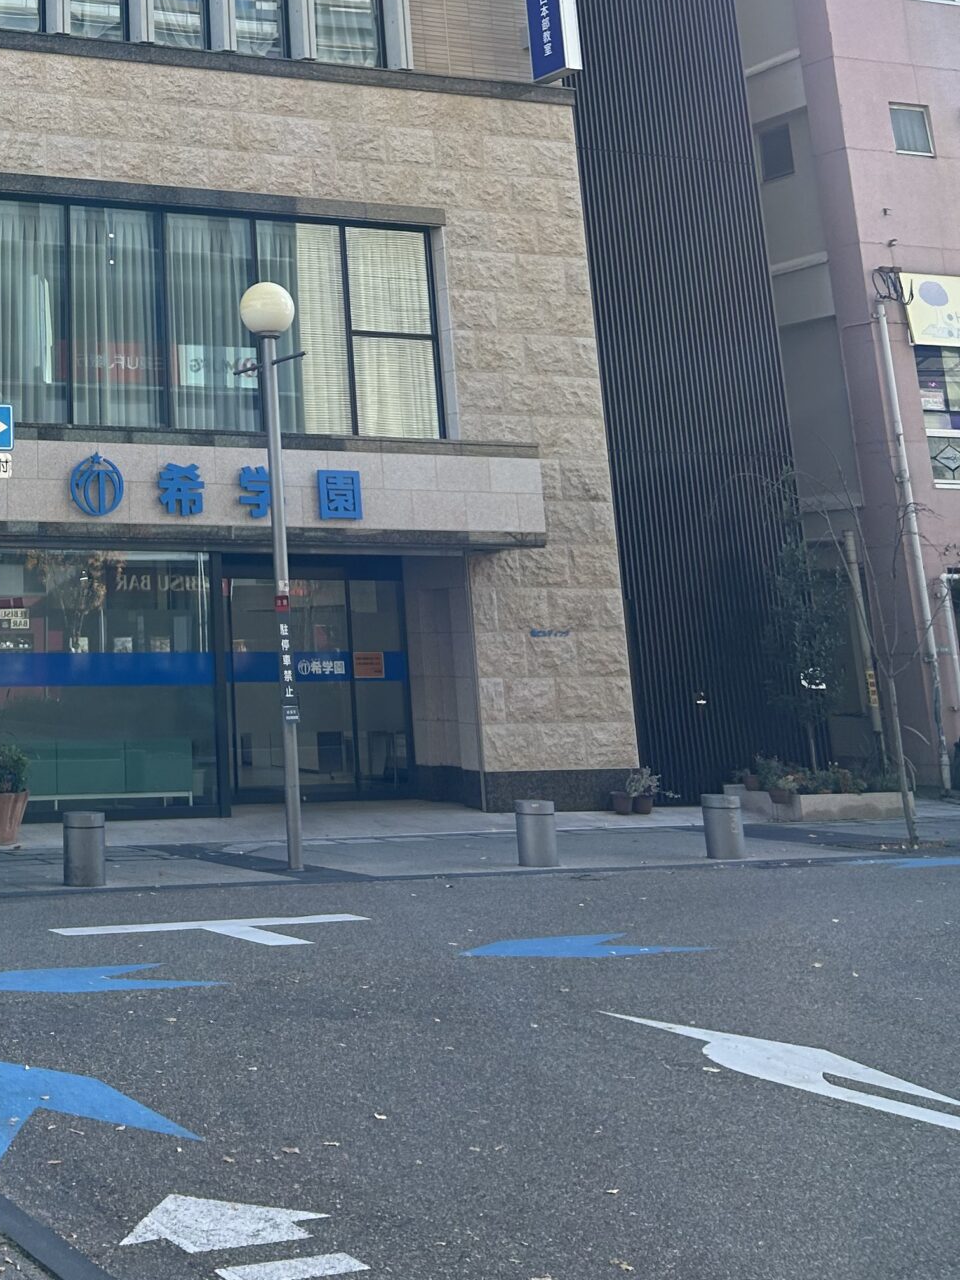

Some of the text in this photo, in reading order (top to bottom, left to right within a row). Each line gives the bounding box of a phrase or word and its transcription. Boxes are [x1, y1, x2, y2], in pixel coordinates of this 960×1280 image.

[158, 463, 363, 520] 希学園
[279, 623, 294, 698] 駐停車禁止
[311, 660, 346, 675] 希学園
